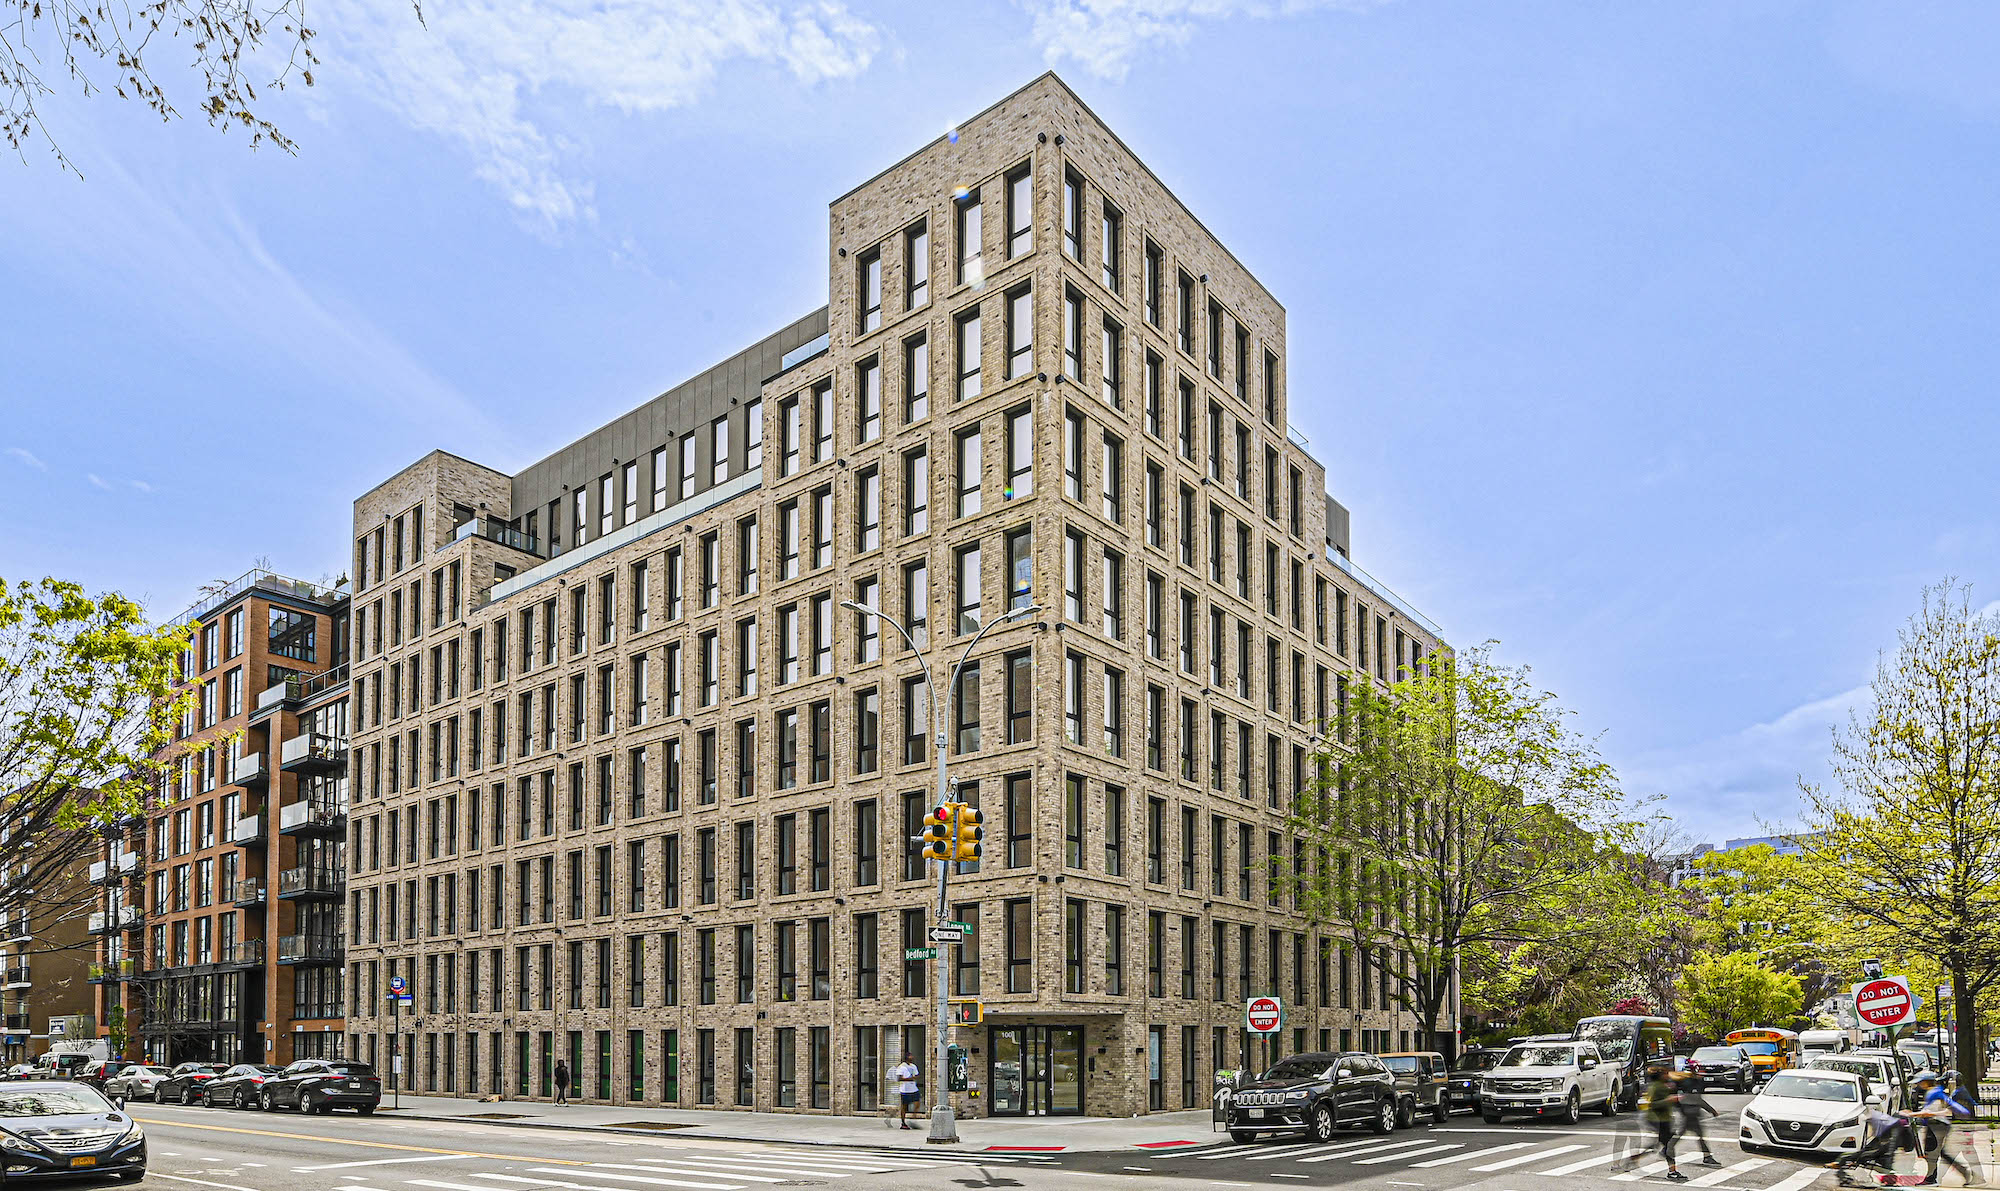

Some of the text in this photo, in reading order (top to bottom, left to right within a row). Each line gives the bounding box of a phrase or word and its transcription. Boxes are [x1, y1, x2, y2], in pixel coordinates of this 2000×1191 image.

[906, 949, 929, 959] Bedford
[1861, 986, 1900, 1000] DO NOT
[1870, 1006, 1902, 1019] ENTER
